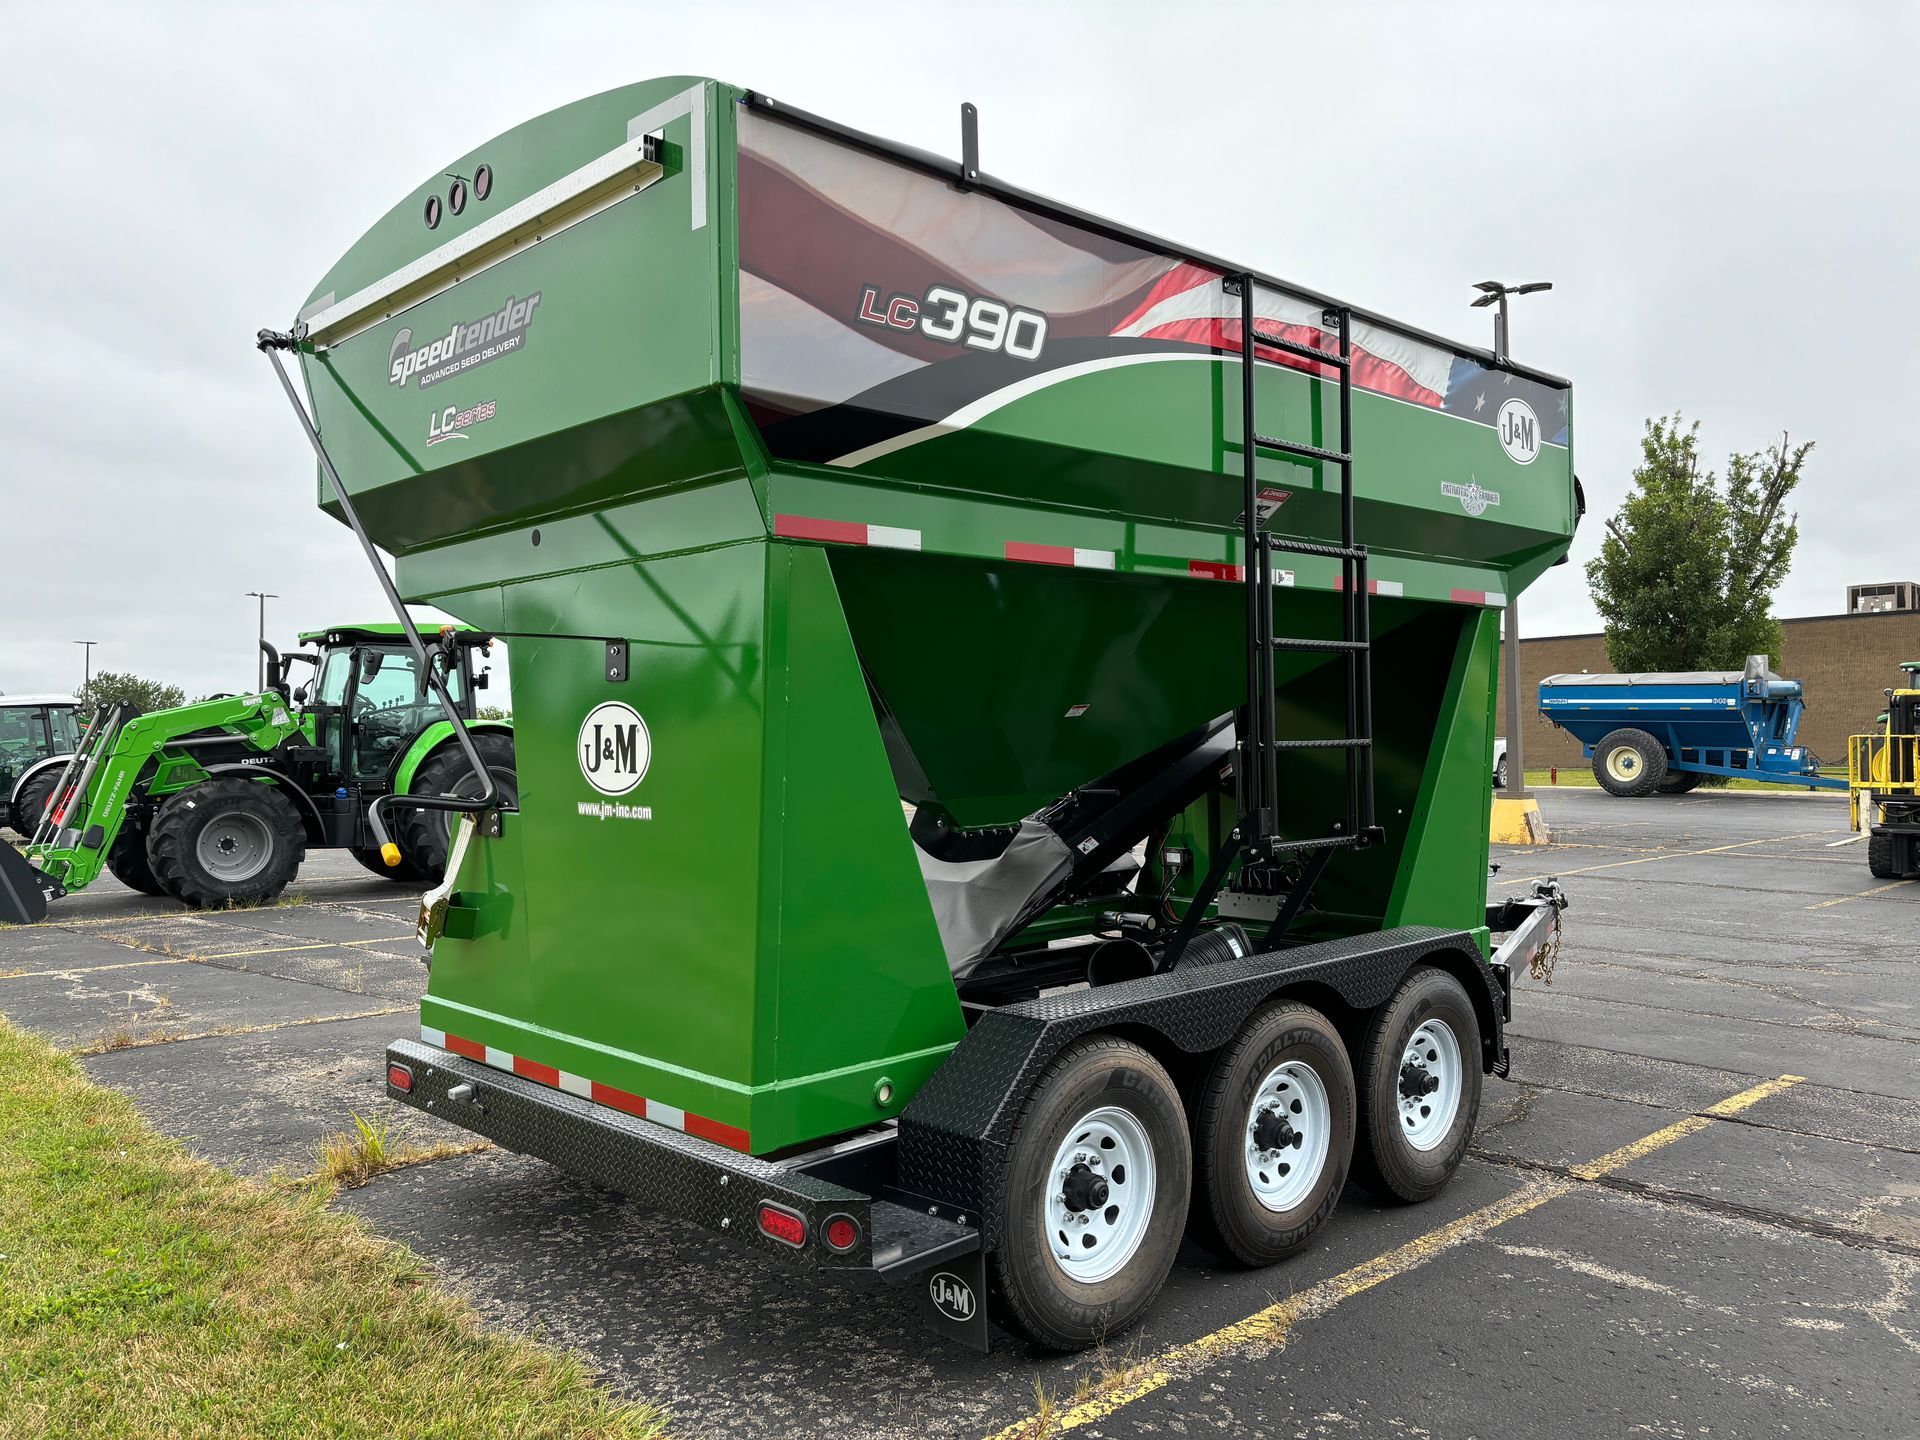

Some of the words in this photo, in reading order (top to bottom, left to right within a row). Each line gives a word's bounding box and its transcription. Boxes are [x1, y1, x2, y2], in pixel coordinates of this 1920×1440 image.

[420, 363, 460, 385] ADVANCED
[460, 354, 481, 369] SEED
[481, 335, 521, 360] DELIVERY
[1501, 411, 1535, 453] J&M
[240, 756, 277, 766] DEUTZ
[584, 724, 638, 774] J&M
[577, 800, 652, 821] www.jm-inc.com
[932, 1278, 970, 1315] J&M
